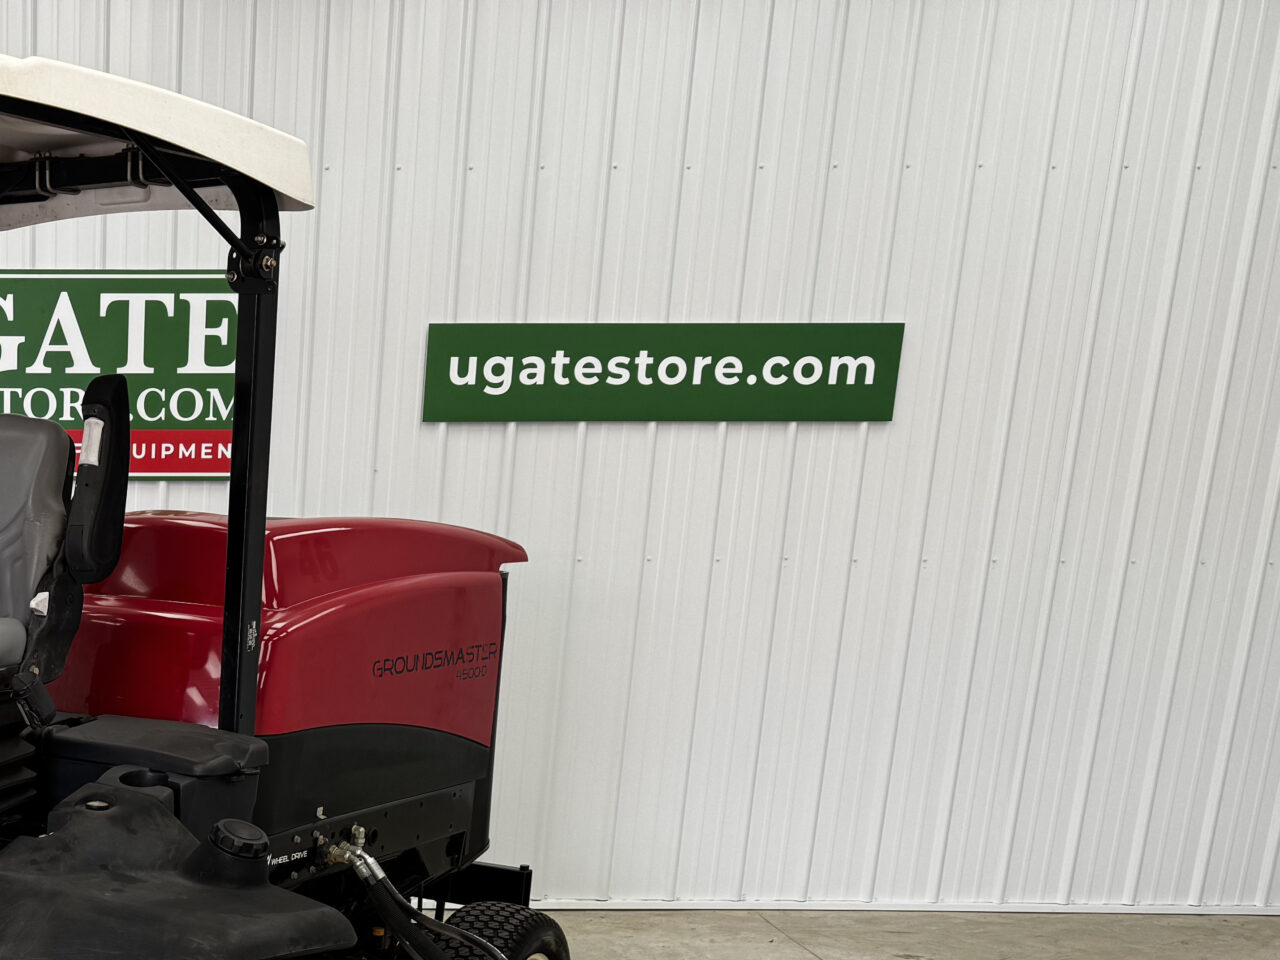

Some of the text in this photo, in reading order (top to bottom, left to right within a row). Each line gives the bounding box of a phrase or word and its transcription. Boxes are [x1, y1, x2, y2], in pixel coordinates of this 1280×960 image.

[448, 350, 876, 396] ugatestore.com
[372, 642, 498, 678] GROUNDSMASTER
[271, 855, 290, 865] WHEEL
[291, 850, 308, 861] DRIVE
